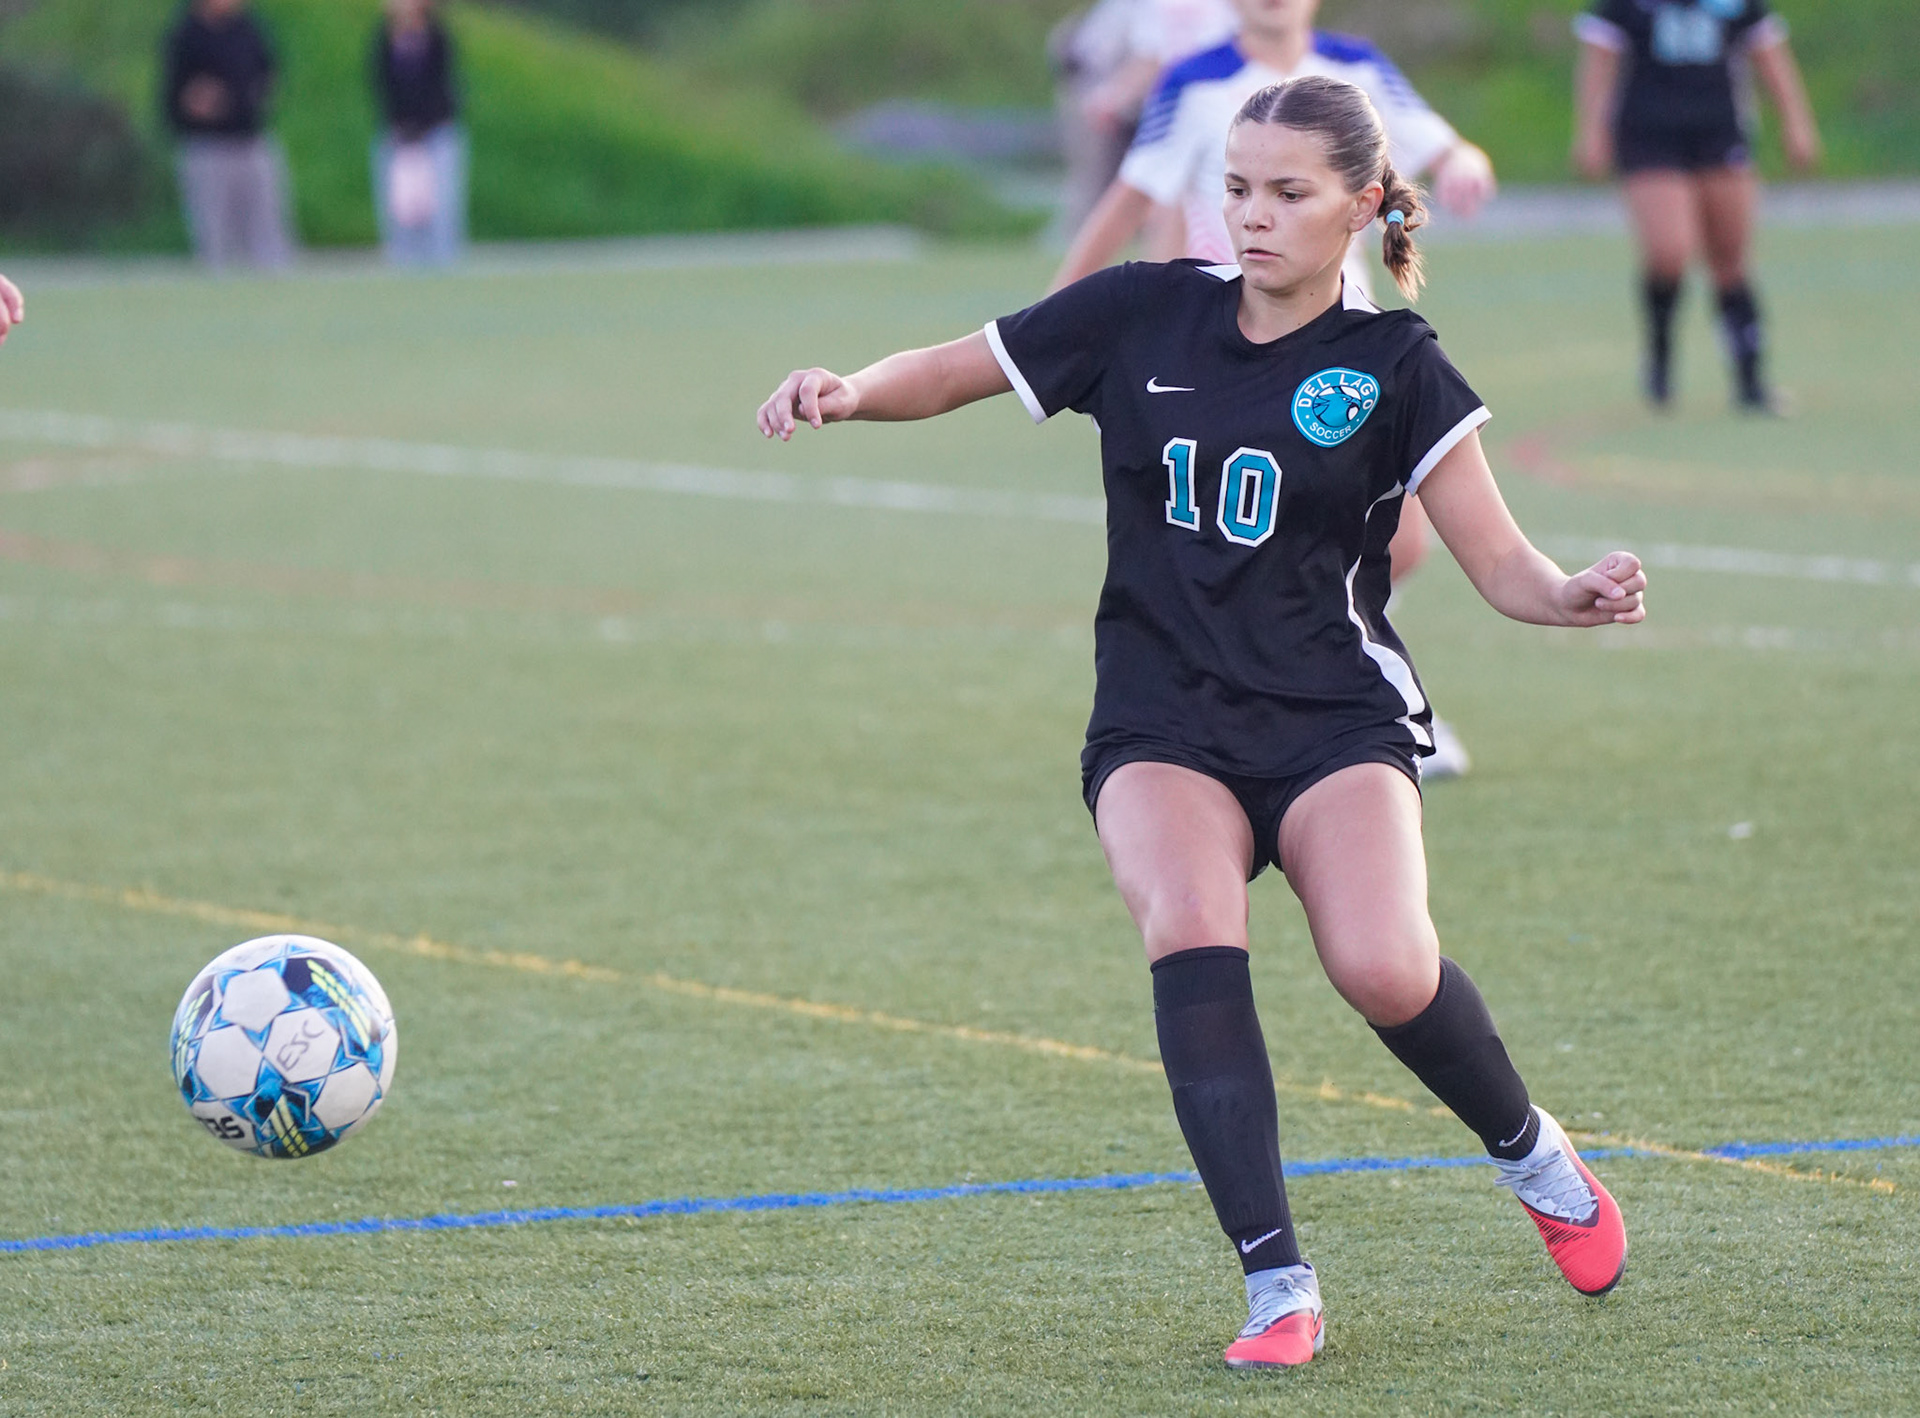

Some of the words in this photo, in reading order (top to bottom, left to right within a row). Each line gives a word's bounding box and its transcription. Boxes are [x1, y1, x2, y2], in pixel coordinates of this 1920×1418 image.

[1297, 377, 1331, 408] DEL
[1339, 373, 1374, 410] LAGO
[1309, 422, 1352, 439] SOCCER
[1162, 436, 1283, 548] 10
[276, 1019, 325, 1072] ESC
